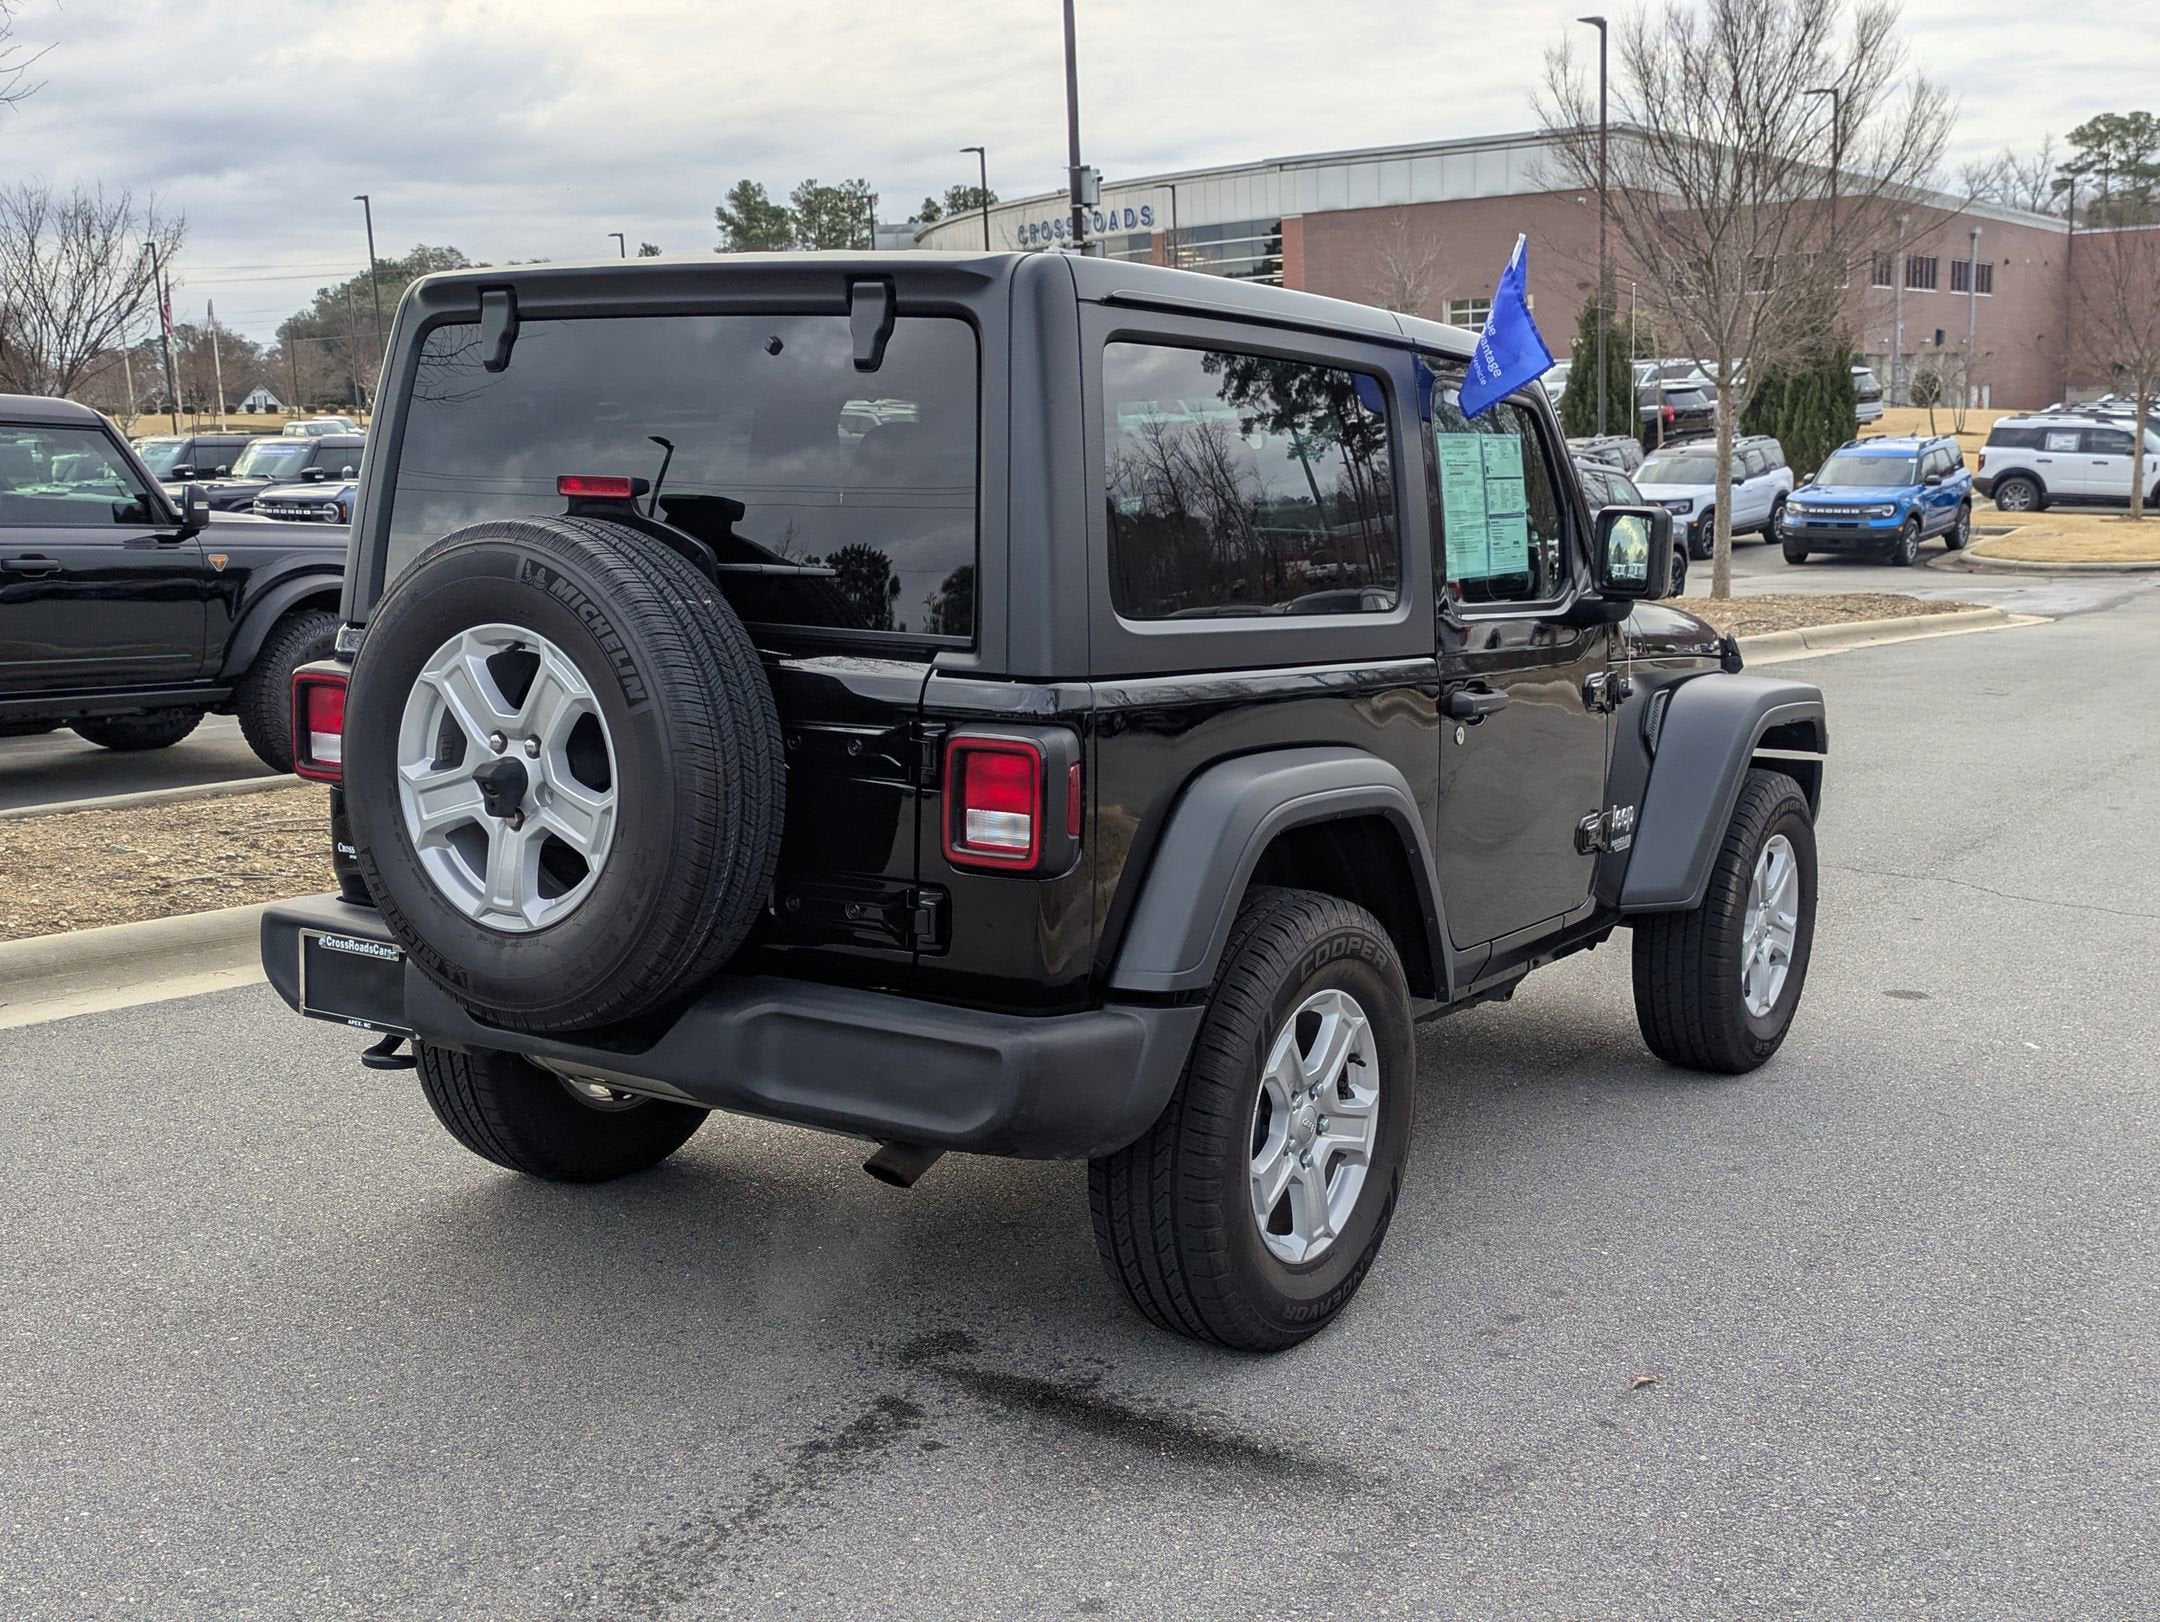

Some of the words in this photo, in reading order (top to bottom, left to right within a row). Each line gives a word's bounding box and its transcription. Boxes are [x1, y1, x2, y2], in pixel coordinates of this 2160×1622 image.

[550, 577, 648, 700] MICHELIN
[1611, 805, 1634, 832] Jeep
[1301, 935, 1388, 982] COOPER
